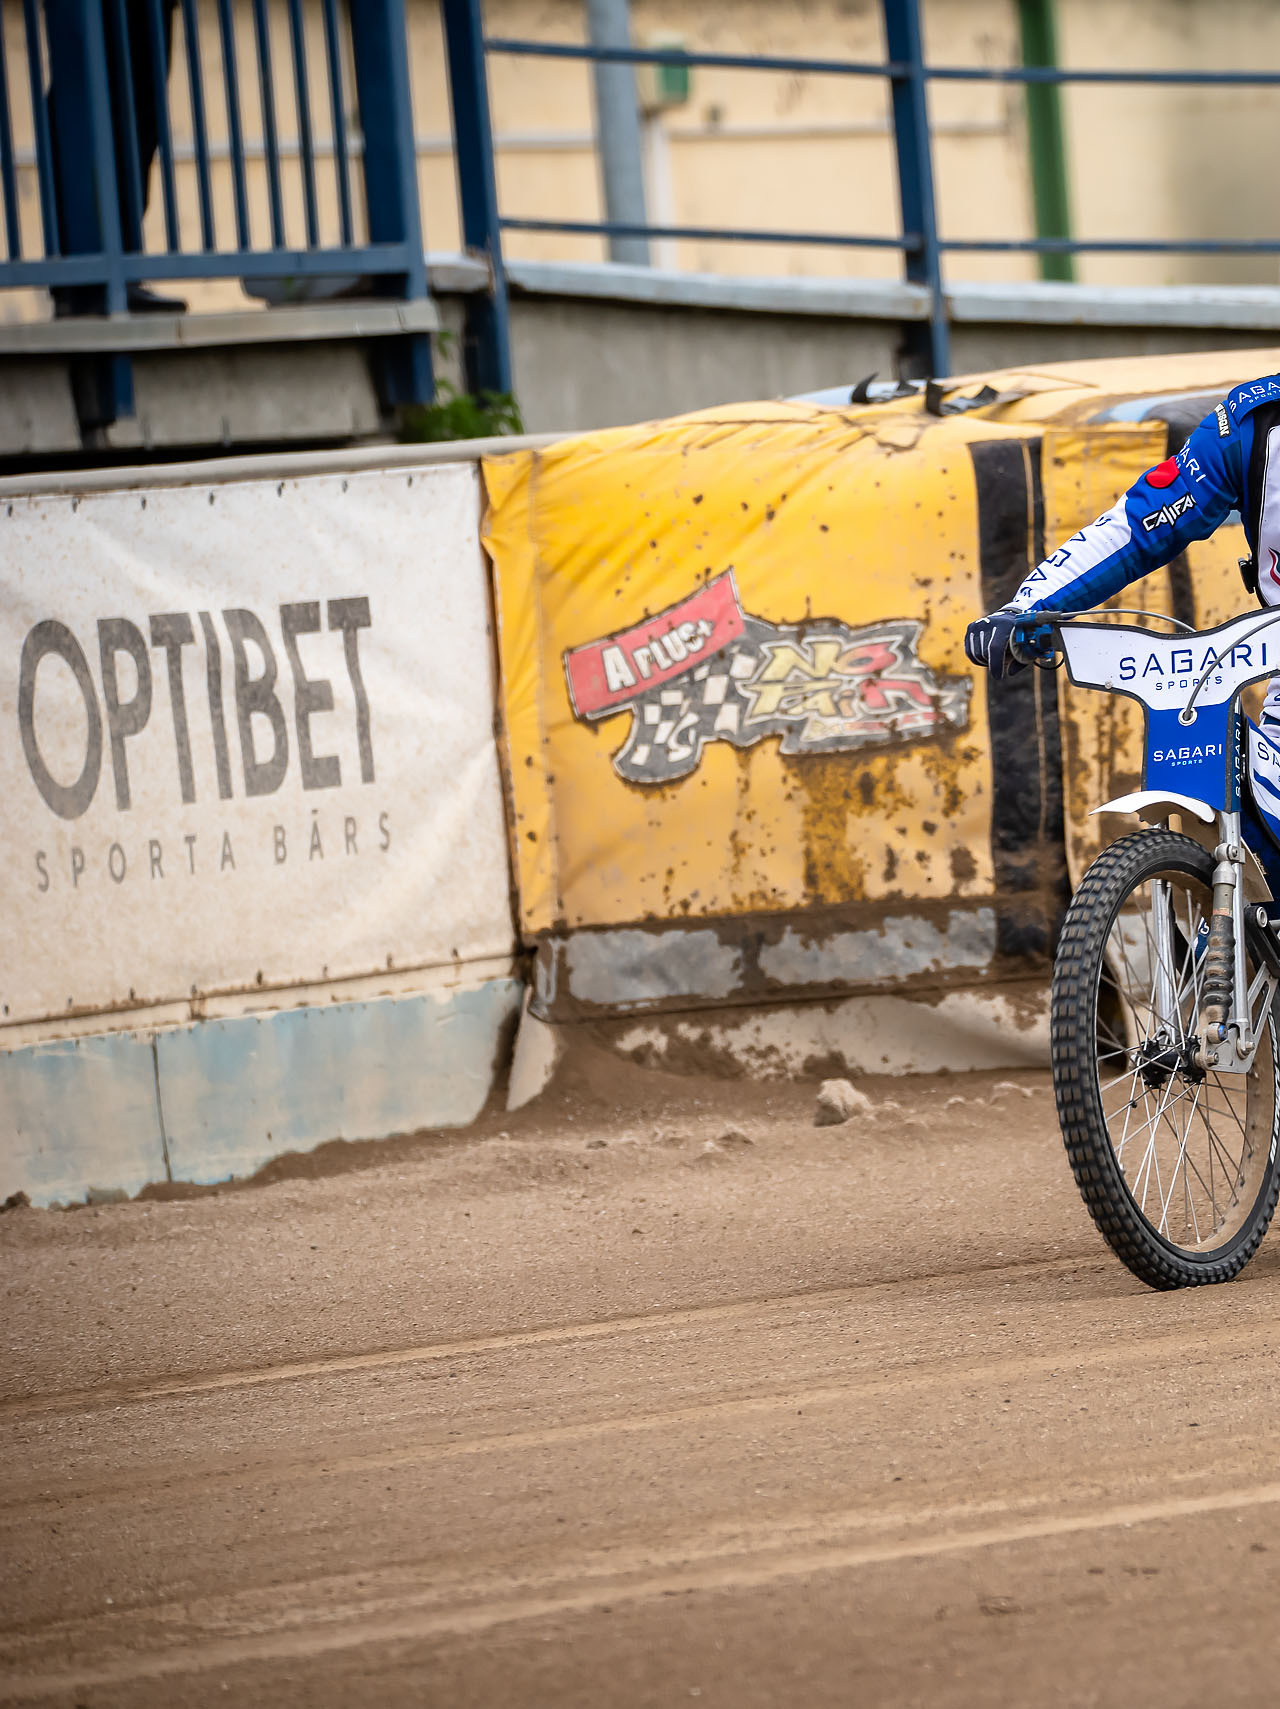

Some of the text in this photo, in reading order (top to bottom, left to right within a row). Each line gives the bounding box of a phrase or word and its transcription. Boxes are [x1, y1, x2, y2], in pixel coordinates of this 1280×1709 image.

[1119, 643, 1266, 681] SAGARI
[1155, 676, 1223, 690] SPORTS
[18, 596, 375, 821] OPTIBET
[1153, 743, 1222, 762] SAGARI
[1171, 759, 1203, 767] SPORTS
[36, 809, 391, 893] SPORTA BĀRS
